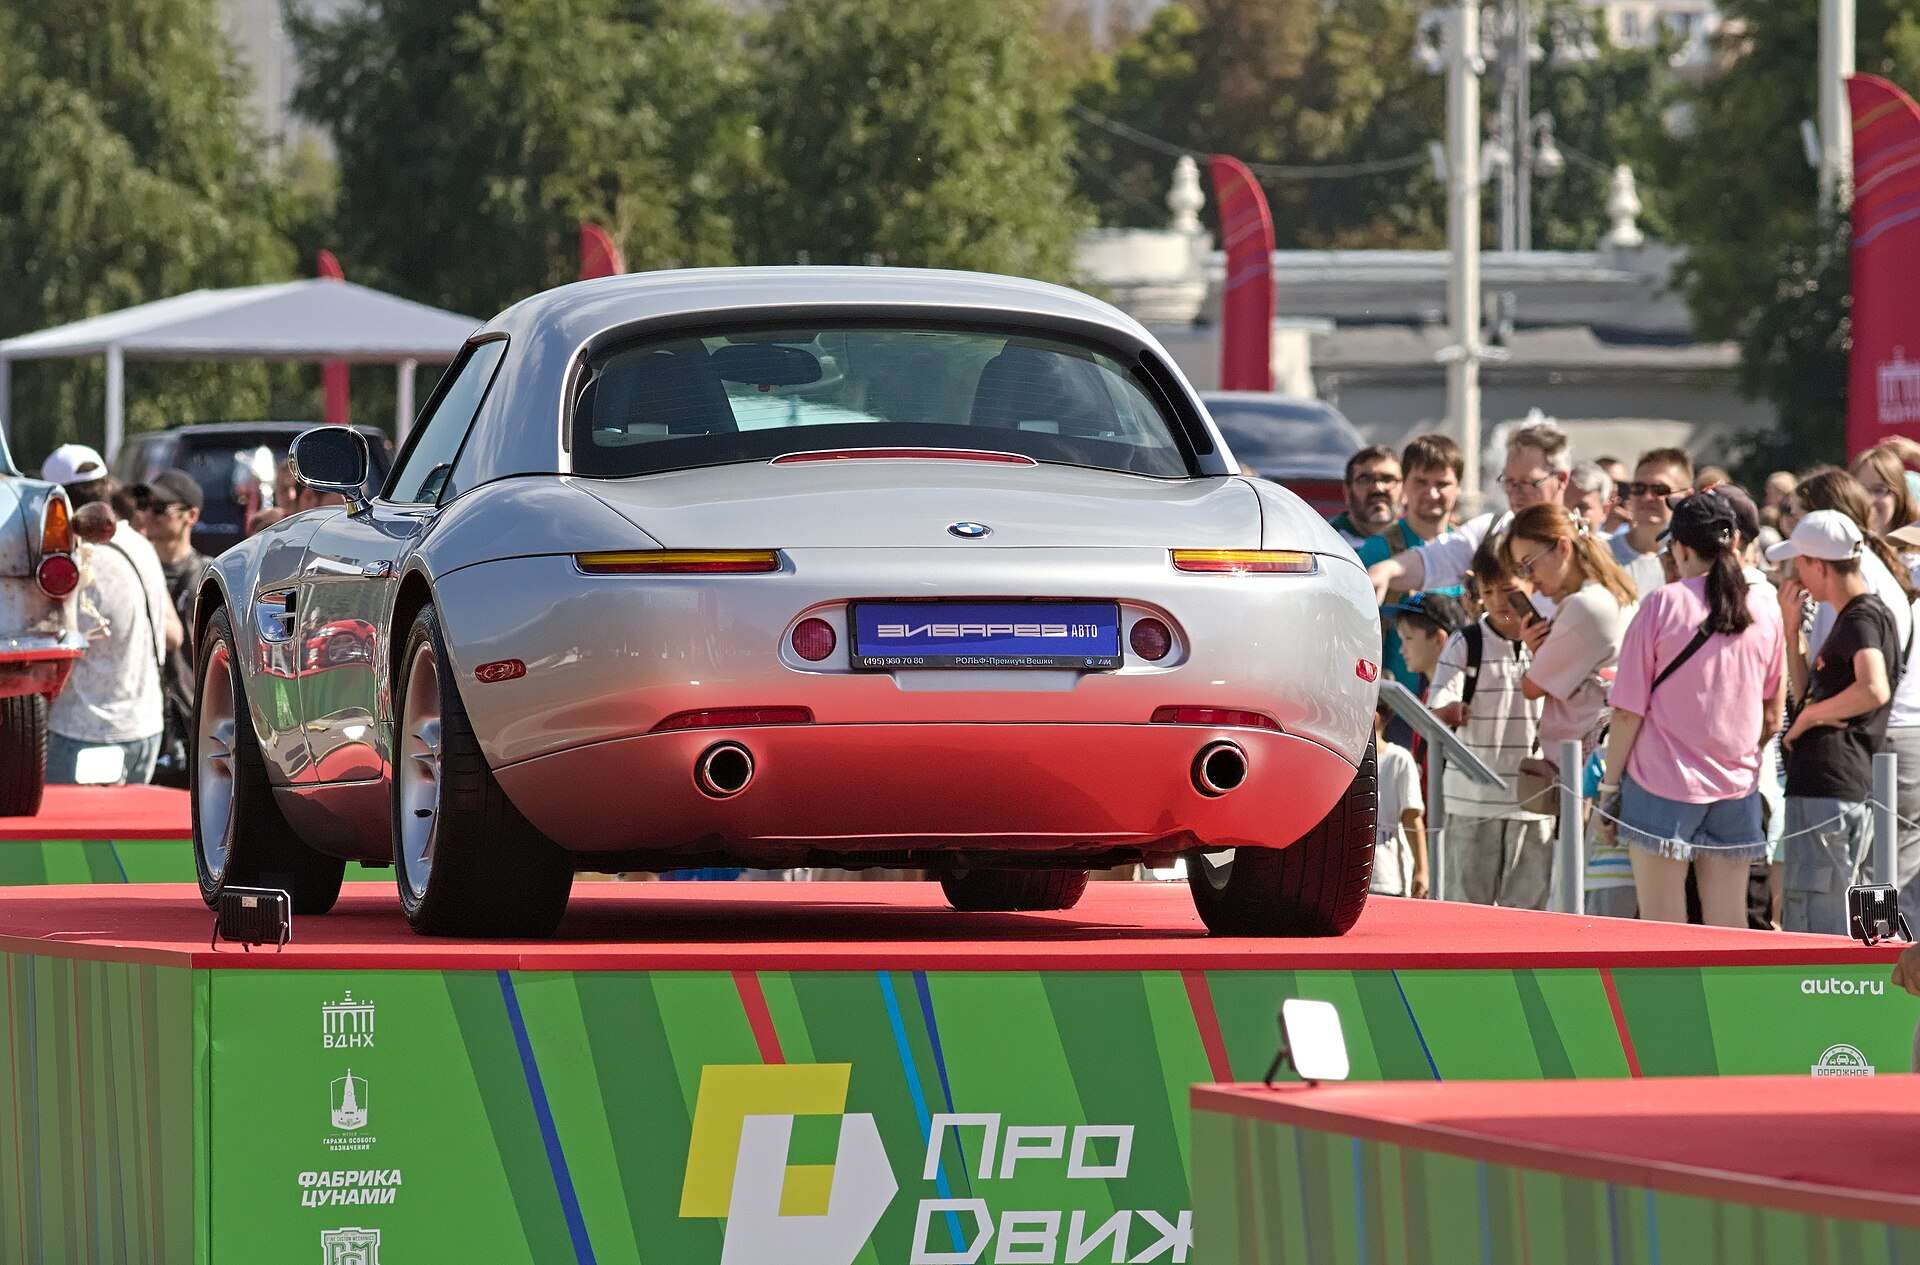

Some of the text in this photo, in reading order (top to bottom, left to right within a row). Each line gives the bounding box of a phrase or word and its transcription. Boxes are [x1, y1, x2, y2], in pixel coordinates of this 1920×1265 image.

[1071, 624, 1098, 637] АВТО
[863, 657, 885, 666] (495)
[903, 657, 912, 665] 70
[1800, 978, 1884, 995] auto.ru
[323, 1034, 374, 1048] ВДНХ
[298, 1169, 402, 1188] ФАБРИКА
[301, 1188, 396, 1208] ЦУНАМИ
